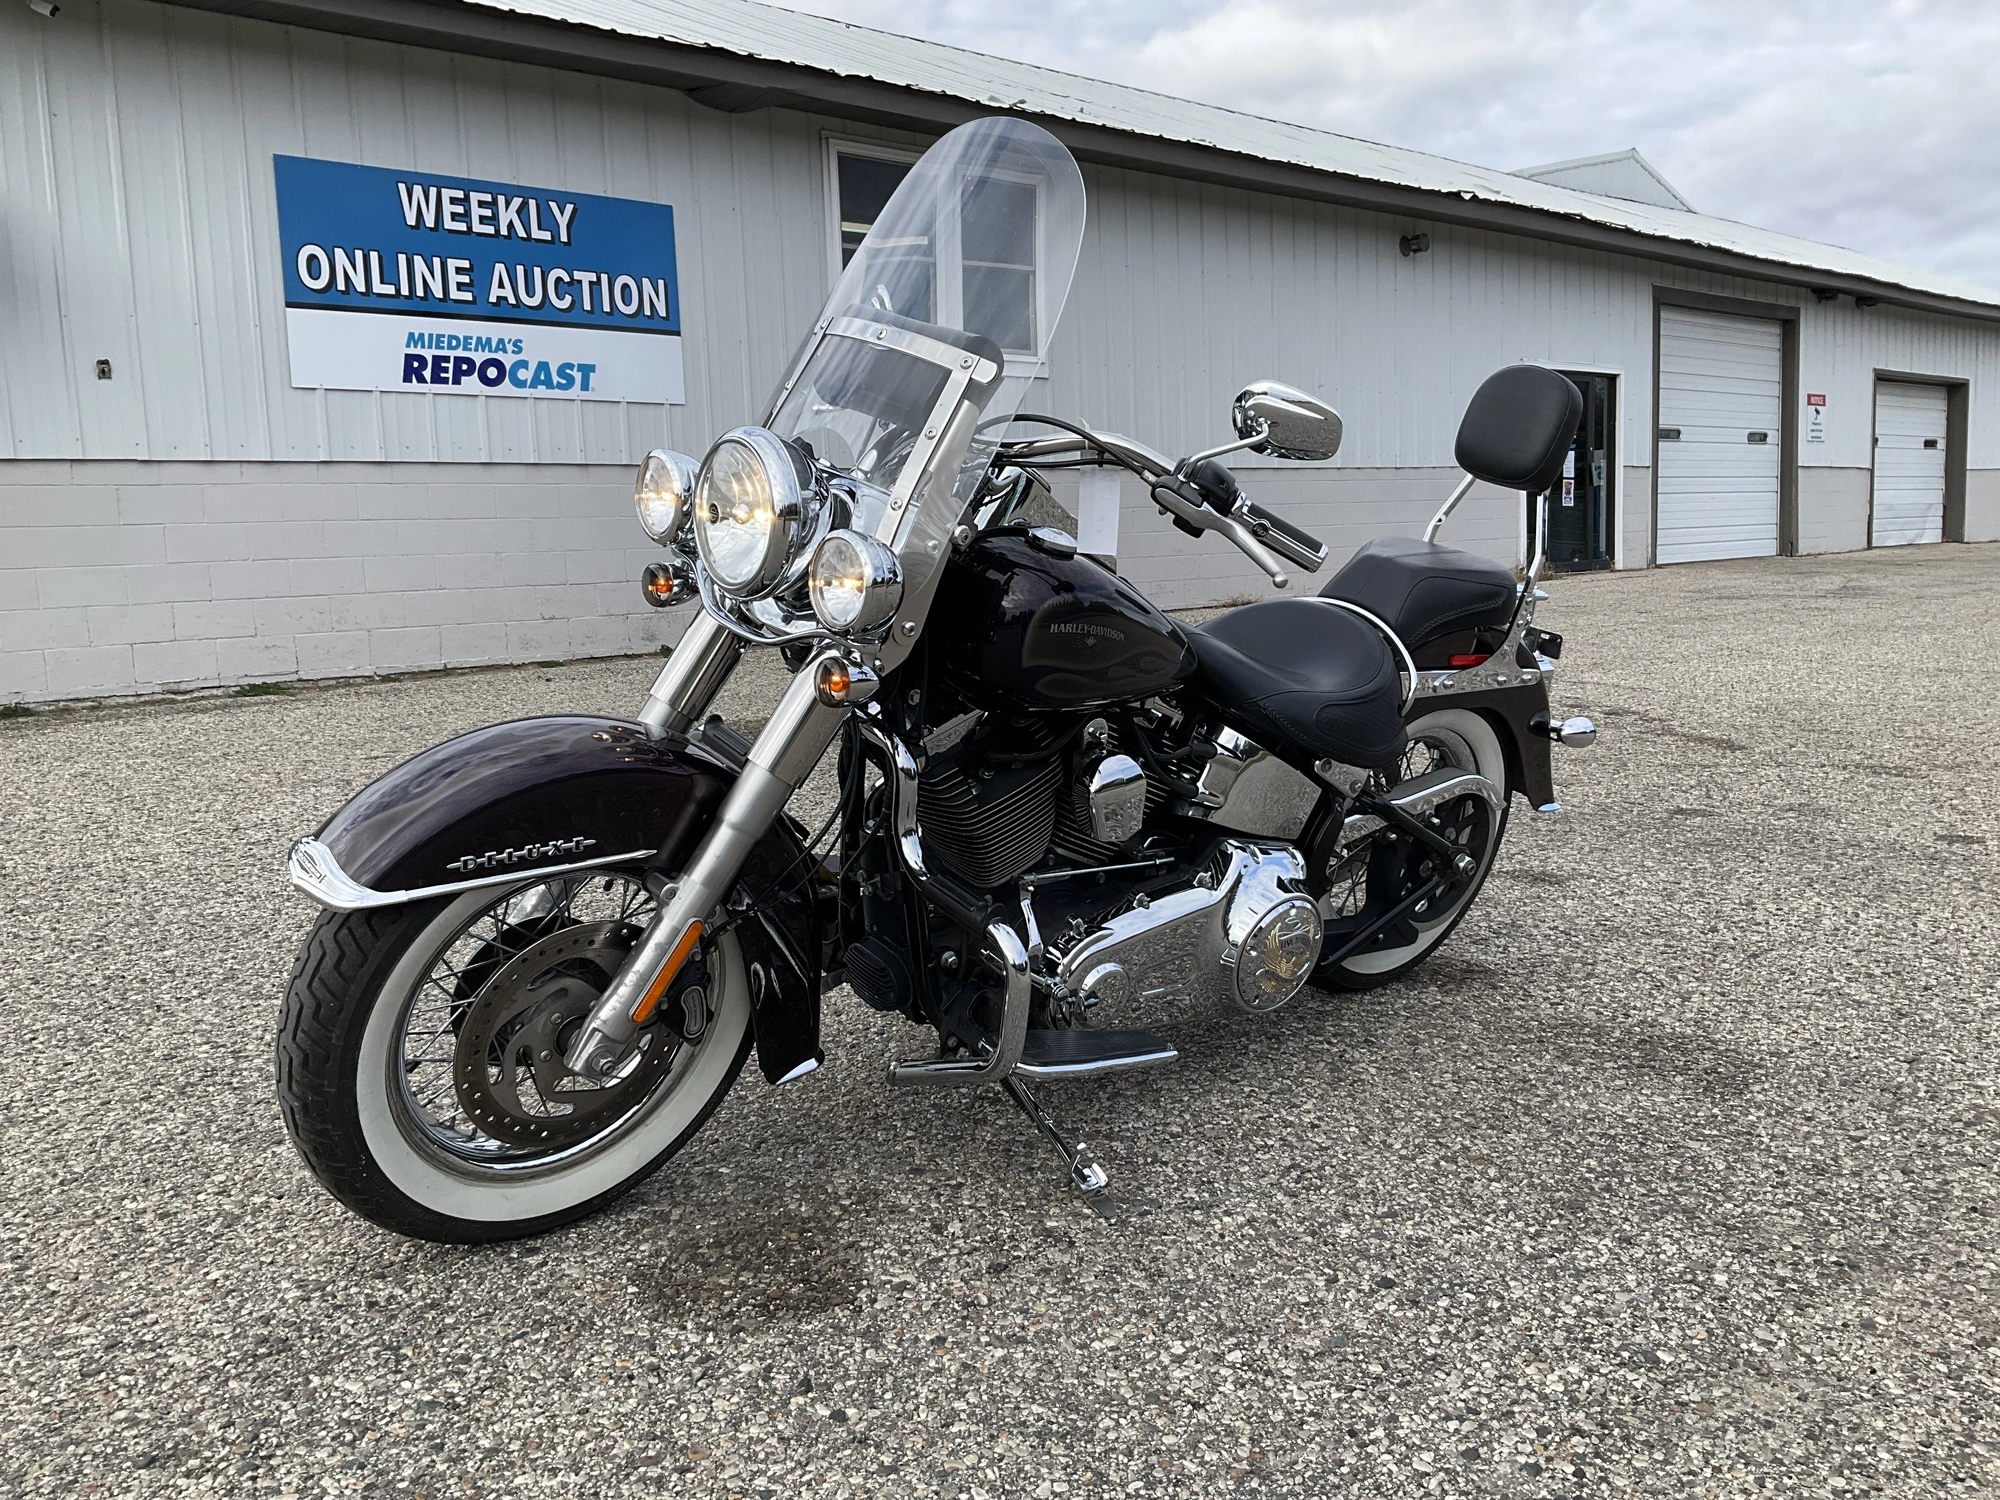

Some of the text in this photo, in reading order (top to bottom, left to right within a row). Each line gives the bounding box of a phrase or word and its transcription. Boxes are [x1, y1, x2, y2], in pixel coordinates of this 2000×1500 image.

[397, 182, 577, 245] WEEKLY
[296, 243, 669, 320] ONLINE AUCTION
[405, 332, 524, 355] MIEDEMA'S
[402, 353, 596, 392] REPOCAST
[1810, 396, 1824, 405] NOTICE
[1050, 623, 1125, 642] HARLEY-DAVIDSON
[460, 836, 584, 872] DELUXE
